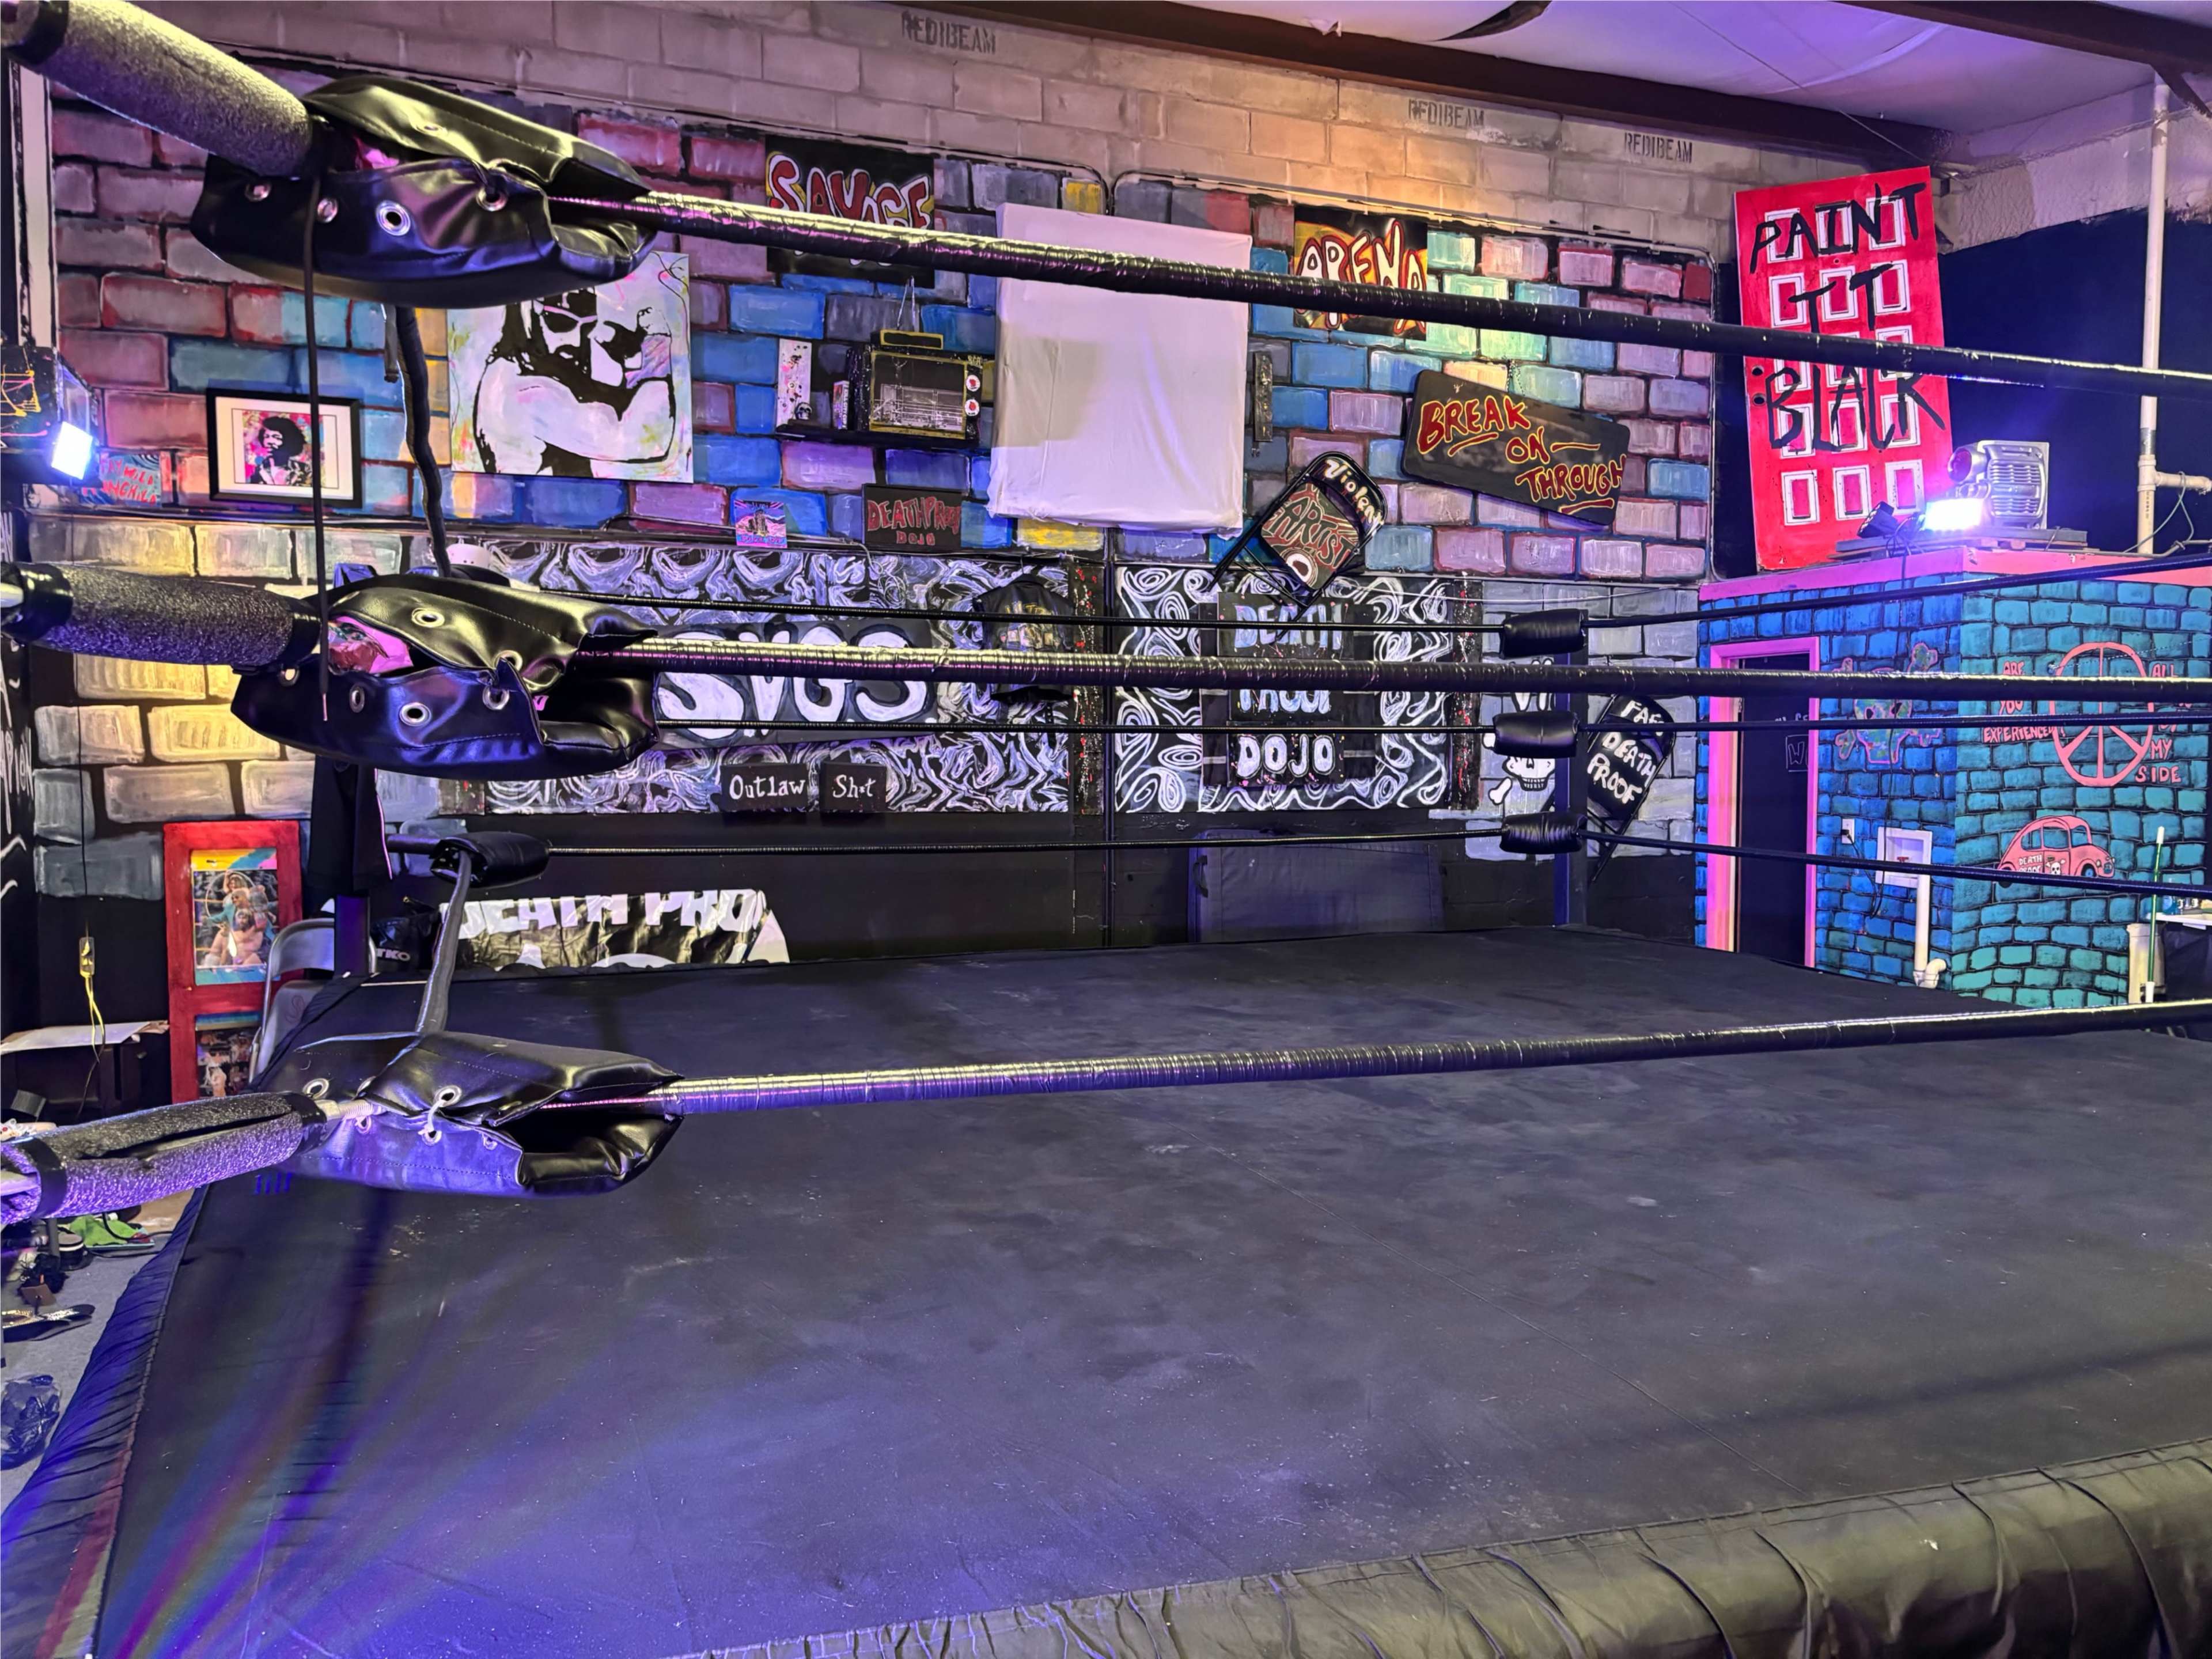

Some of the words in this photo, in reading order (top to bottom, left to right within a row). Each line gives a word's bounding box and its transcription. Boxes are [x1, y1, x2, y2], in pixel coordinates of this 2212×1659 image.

[902, 10, 996, 55] REDIBEAM
[1624, 132, 1692, 163] REDIBEAM
[1749, 183, 1926, 274] PAINT
[1417, 395, 1531, 455] BREAK
[1505, 426, 1550, 464] ON
[1515, 454, 1627, 502] THROUGH
[896, 531, 935, 546] DOJO
[1237, 733, 1335, 779] DOJO
[1603, 732, 1657, 787] DEATH
[2150, 738, 2173, 760] MY
[729, 775, 806, 800] Outlaw
[1587, 753, 1642, 805] PROOF
[2135, 765, 2181, 783] SIDE
[2018, 854, 2043, 866] DEATH
